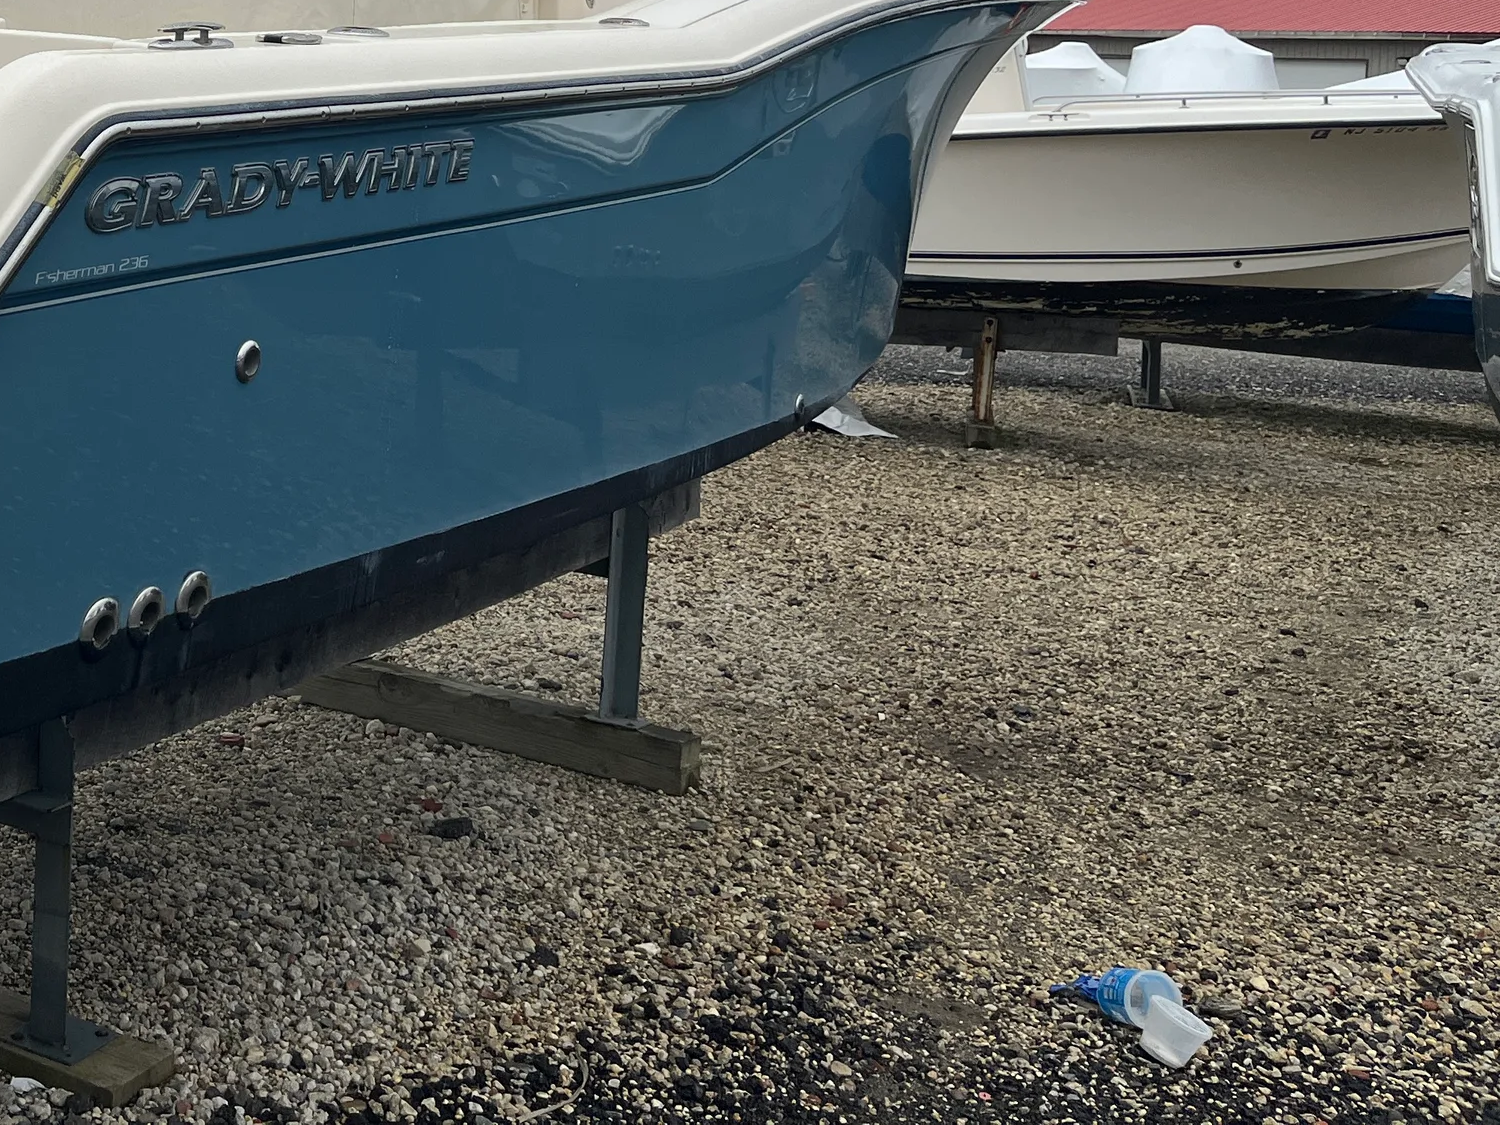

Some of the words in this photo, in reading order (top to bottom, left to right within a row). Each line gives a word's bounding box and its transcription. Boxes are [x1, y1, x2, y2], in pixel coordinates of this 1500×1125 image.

[84, 138, 476, 233] GRADY-WHITE
[35, 263, 115, 285] Fsherman
[118, 254, 150, 272] 236
